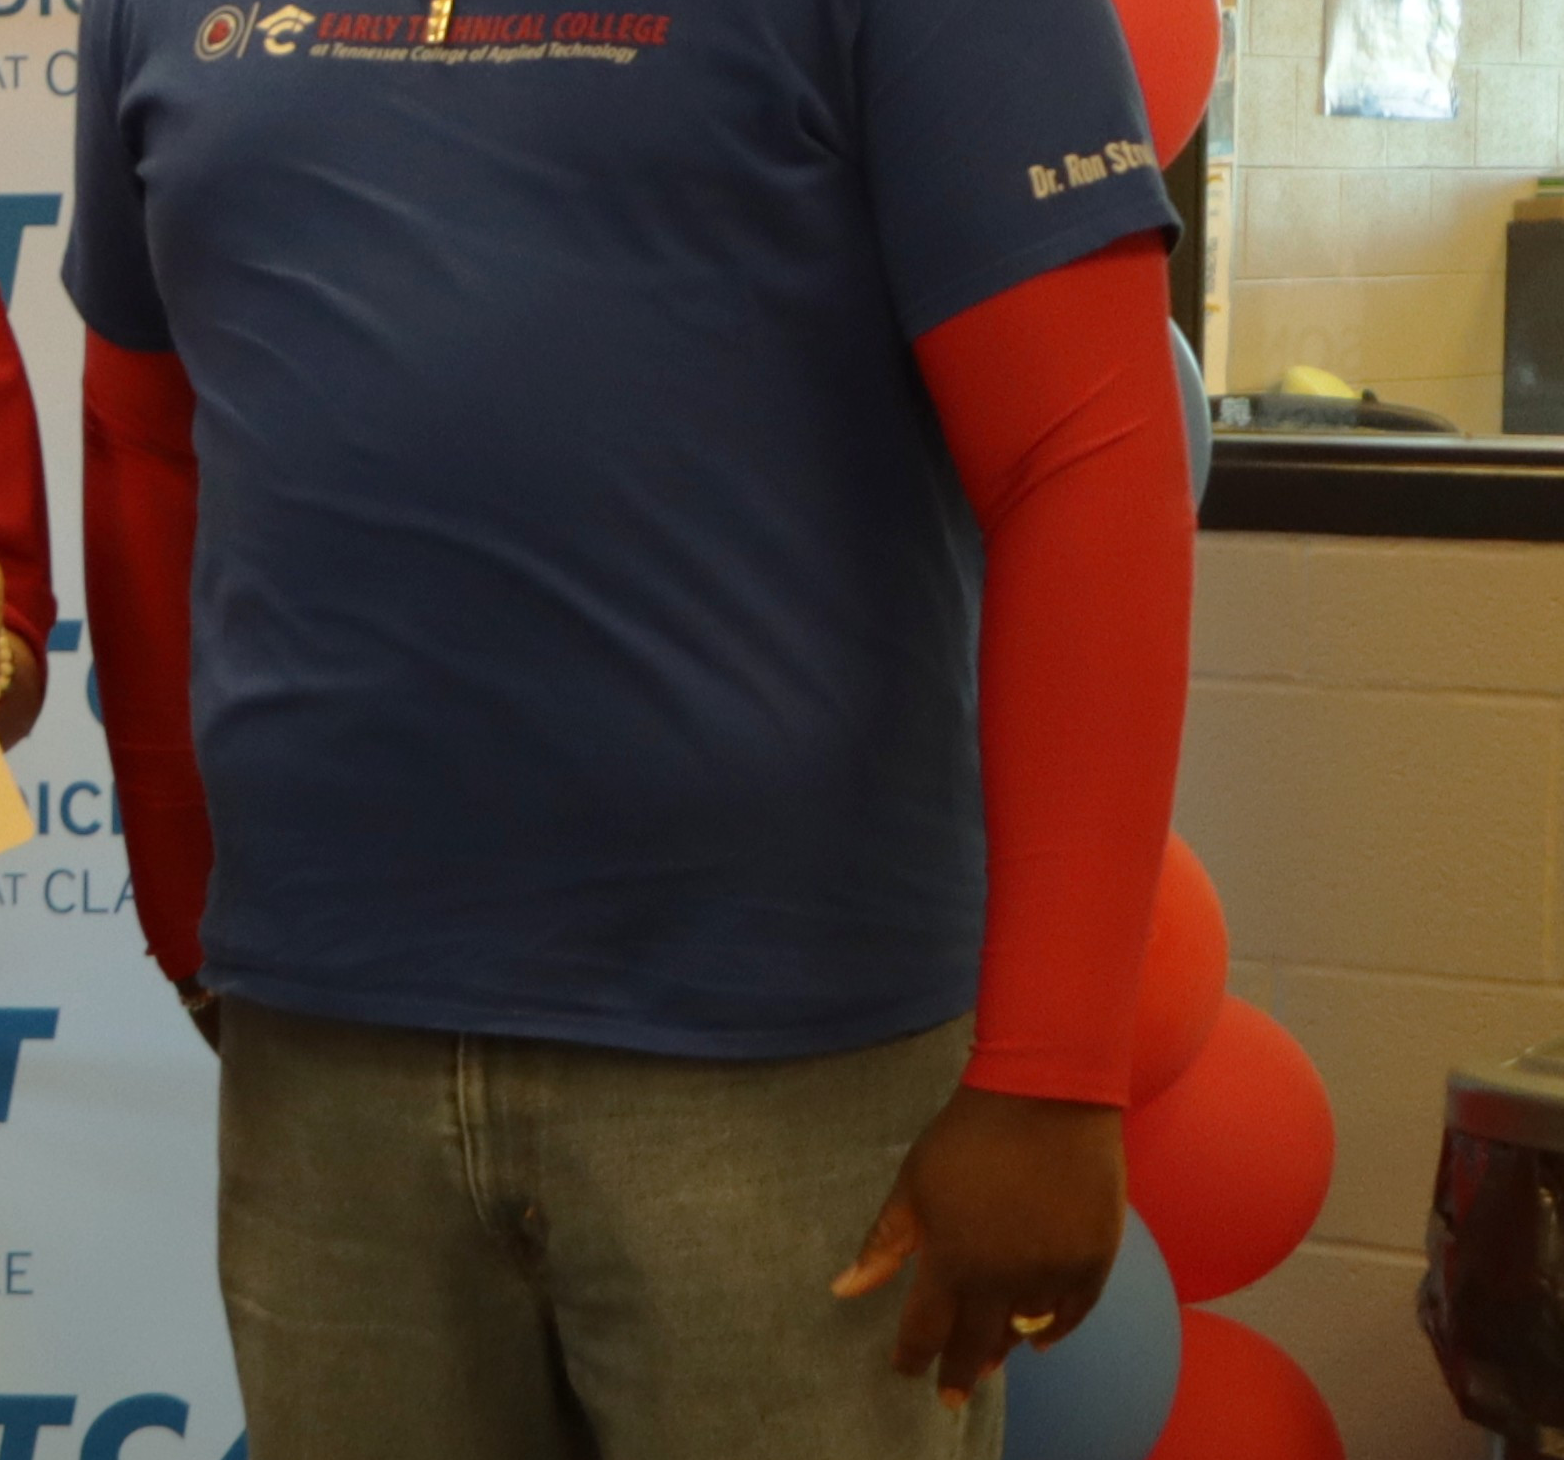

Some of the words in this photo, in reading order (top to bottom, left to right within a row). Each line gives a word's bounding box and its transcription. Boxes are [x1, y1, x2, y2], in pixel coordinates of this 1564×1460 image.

[317, 11, 403, 42] EARLY
[406, 12, 546, 43] THNICAL
[551, 11, 672, 46] COLLEGE
[331, 41, 409, 62] Tennessee
[410, 44, 471, 65] College
[468, 43, 489, 61] of
[486, 42, 548, 64] Applied
[548, 41, 639, 65] Technology
[1028, 164, 1066, 201] Dr.
[1063, 152, 1108, 188] Ron
